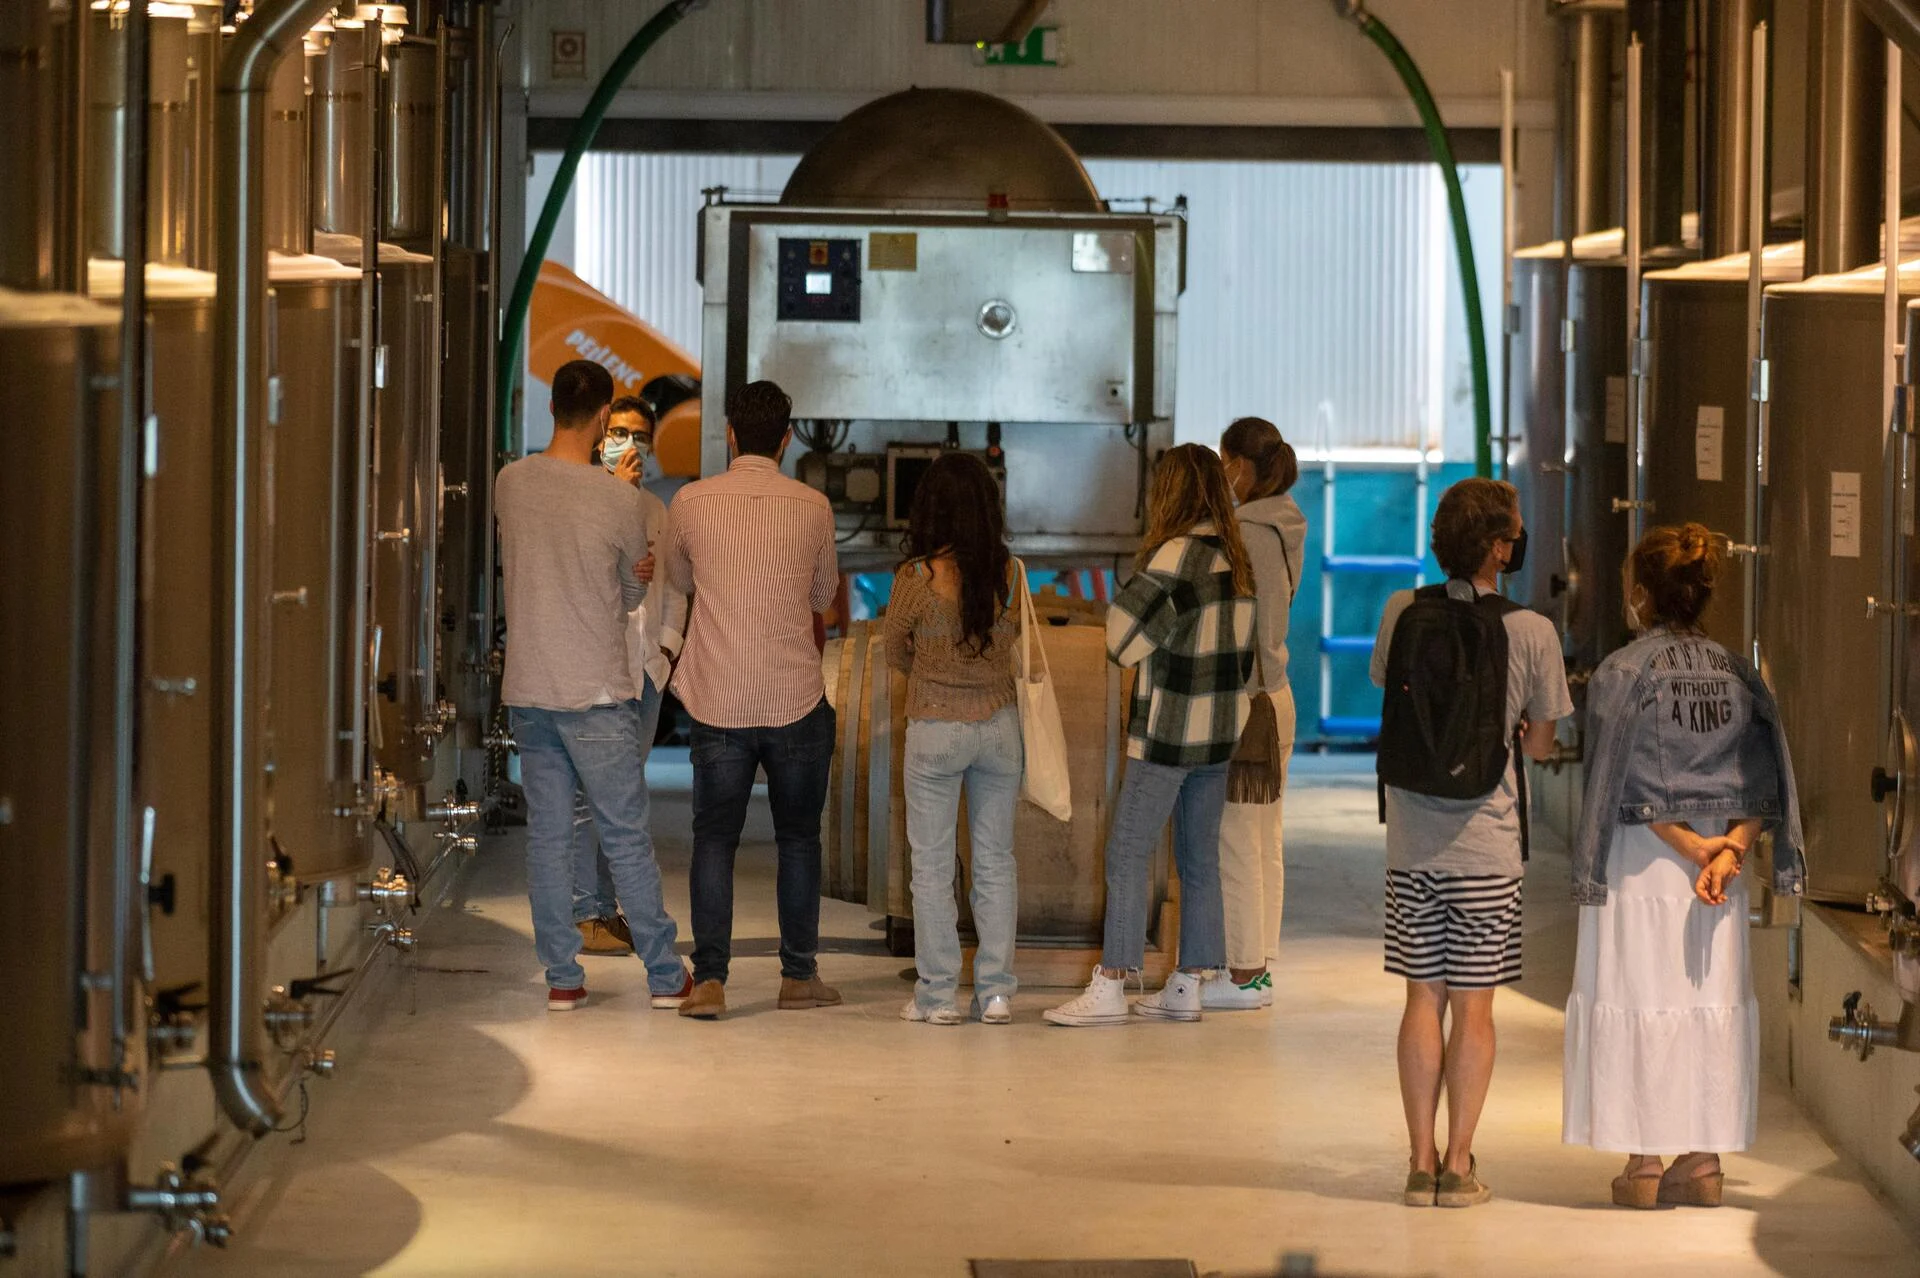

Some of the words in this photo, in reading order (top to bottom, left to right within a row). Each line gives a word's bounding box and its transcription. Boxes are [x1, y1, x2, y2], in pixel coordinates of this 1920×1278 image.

[565, 329, 643, 388] PELLENC
[1671, 681, 1729, 697] WITHOUT
[1672, 700, 1683, 728] A
[1689, 700, 1732, 733] KING
